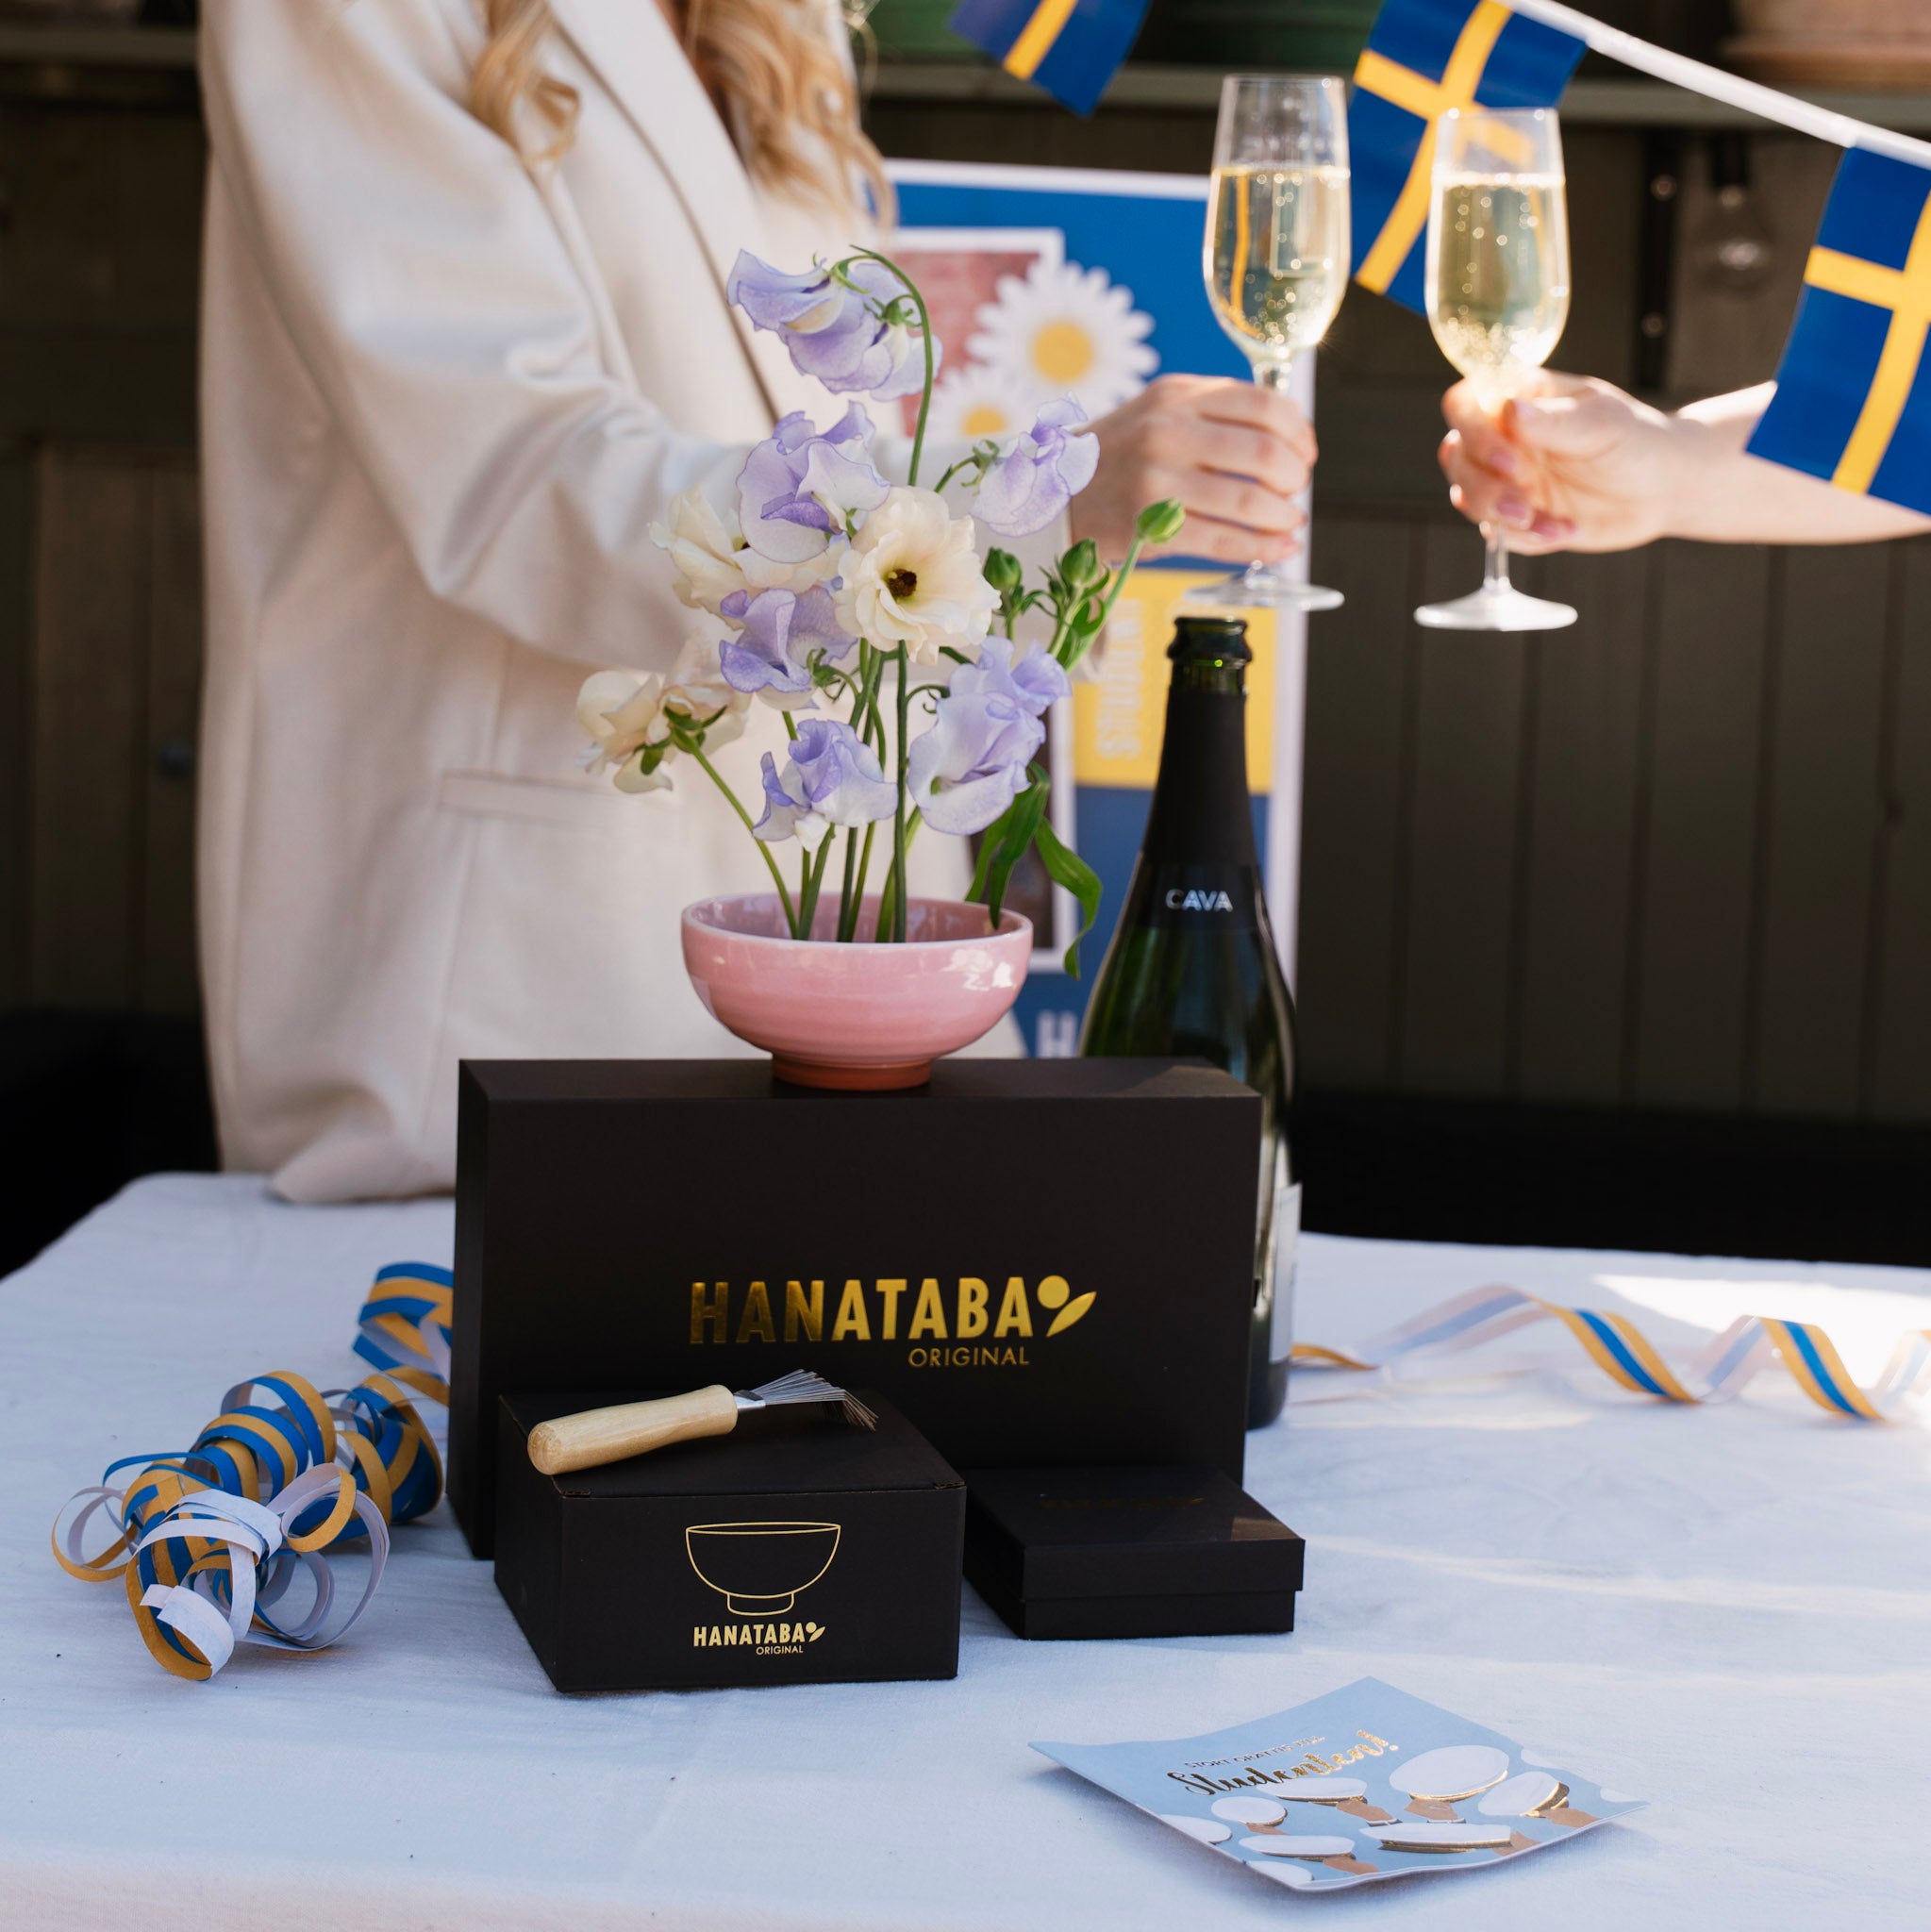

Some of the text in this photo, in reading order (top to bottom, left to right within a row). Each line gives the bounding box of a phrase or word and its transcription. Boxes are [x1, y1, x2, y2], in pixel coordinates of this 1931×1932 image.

[1165, 889, 1234, 912] CAVA
[690, 1276, 1033, 1343] HANATABA
[907, 1347, 1029, 1367] ORIGINAL
[693, 1623, 806, 1646] HANATABA
[756, 1645, 804, 1656] ORIGINAL
[1166, 1730, 1399, 1795] Studenten!
[1184, 1758, 1230, 1769] STORT
[1233, 1744, 1293, 1763] GRATTIS
